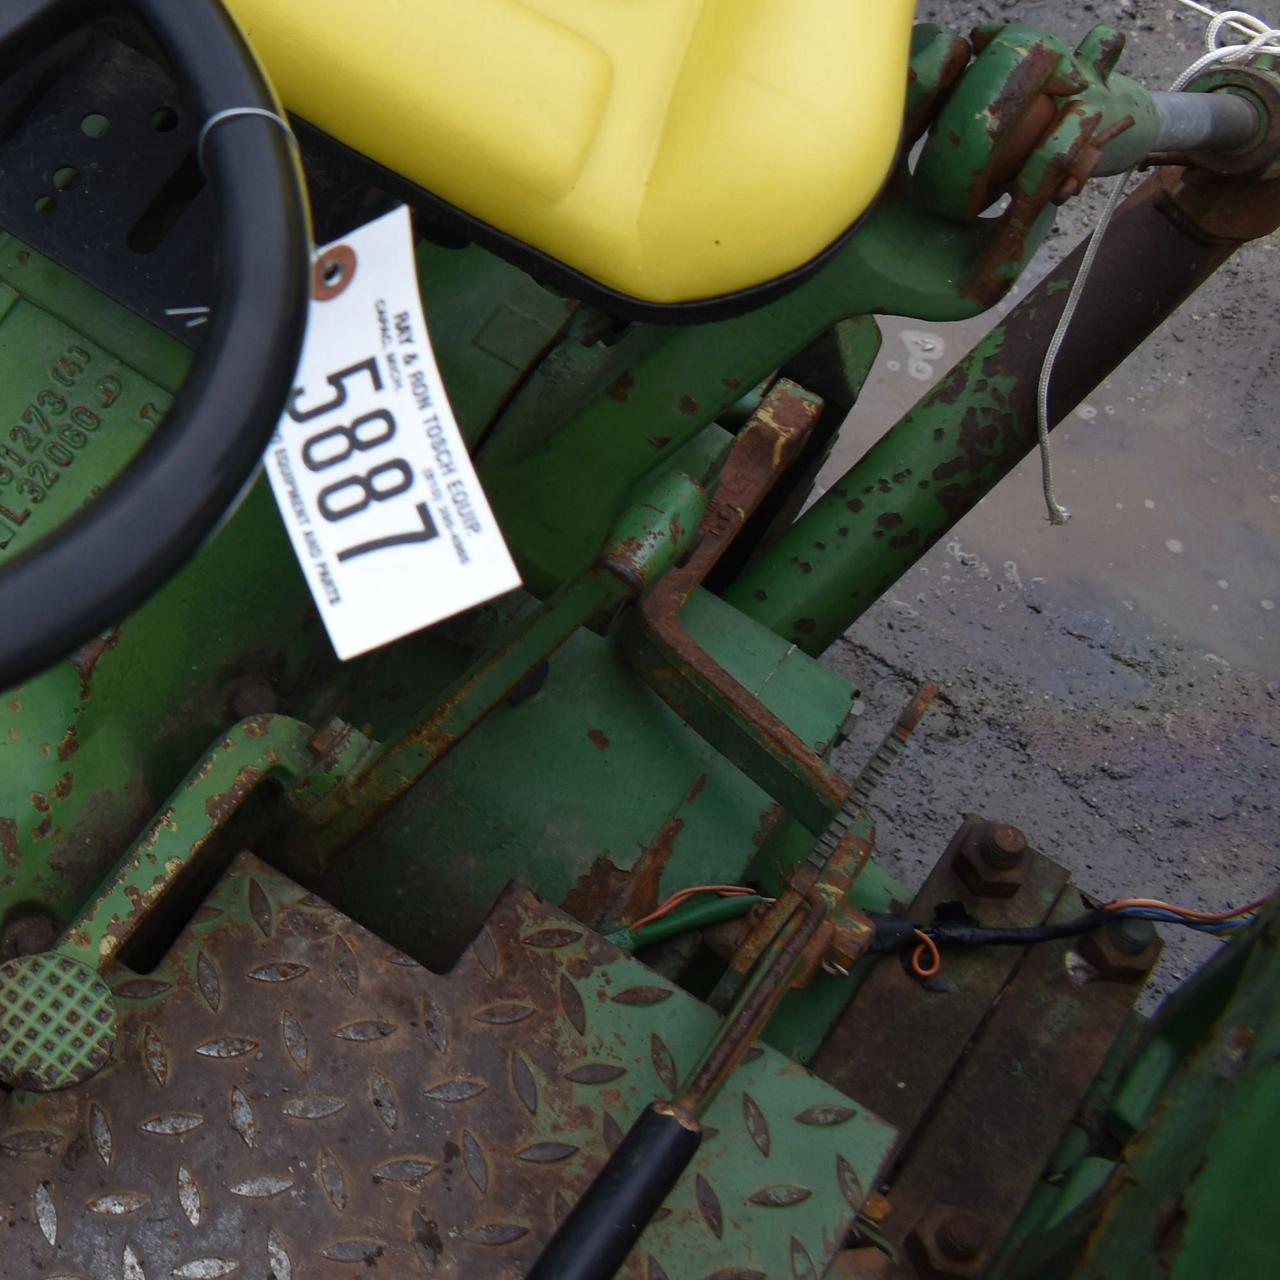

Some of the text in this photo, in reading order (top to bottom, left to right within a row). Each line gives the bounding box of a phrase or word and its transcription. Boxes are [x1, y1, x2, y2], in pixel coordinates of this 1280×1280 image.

[274, 448, 311, 527] EQUIPMENT
[303, 528, 323, 560] AND
[316, 562, 341, 607] PARTS
[289, 355, 440, 563] 5887
[392, 311, 482, 537] RAY & RON TOSCH EQUIP.
